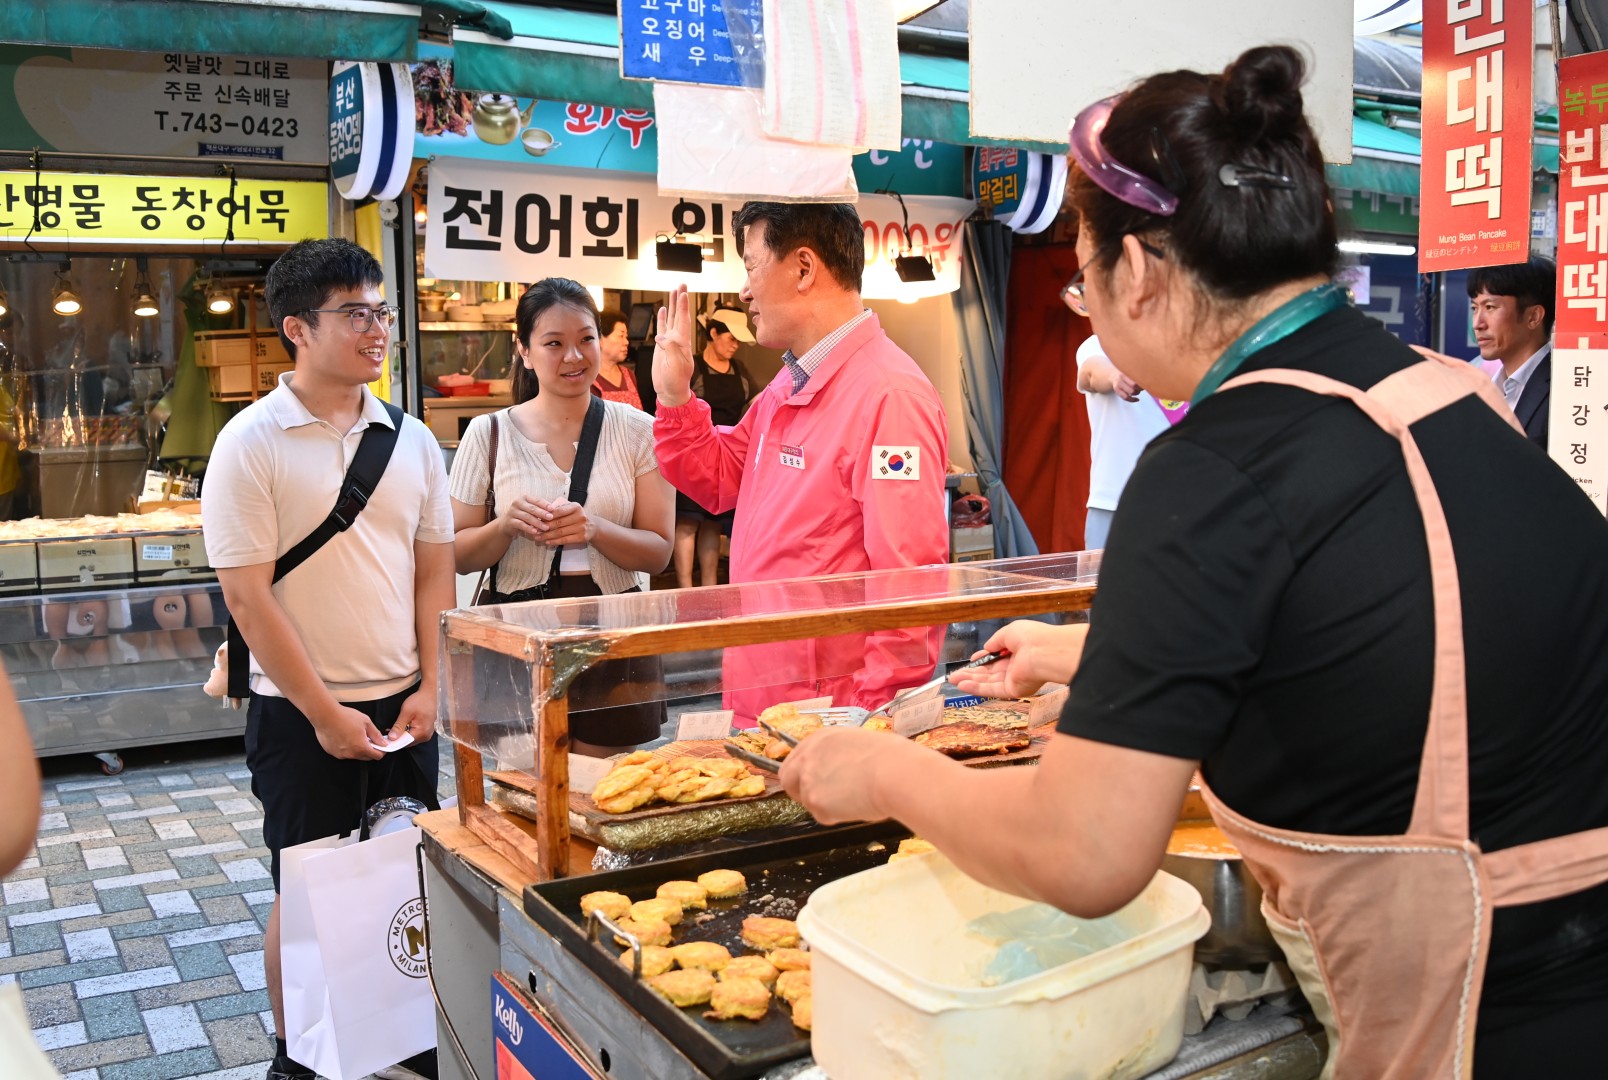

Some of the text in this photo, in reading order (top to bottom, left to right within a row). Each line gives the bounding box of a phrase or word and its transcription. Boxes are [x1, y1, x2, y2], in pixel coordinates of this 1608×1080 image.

[641, 18, 705, 42] 오징어
[164, 53, 291, 80] 옛날맛 그대로
[164, 81, 291, 108] 주문 신속배달
[335, 76, 355, 113] 부산
[154, 110, 299, 138] T.743-0423
[330, 110, 362, 162] 동창오뎅
[980, 173, 1018, 204] 막걸리
[132, 186, 290, 233] 동창어묵
[443, 186, 639, 260] 전어회
[1439, 229, 1507, 244] Mung Bean Pancake
[1570, 366, 1592, 464] 닭강정
[495, 994, 523, 1046] Kelly
